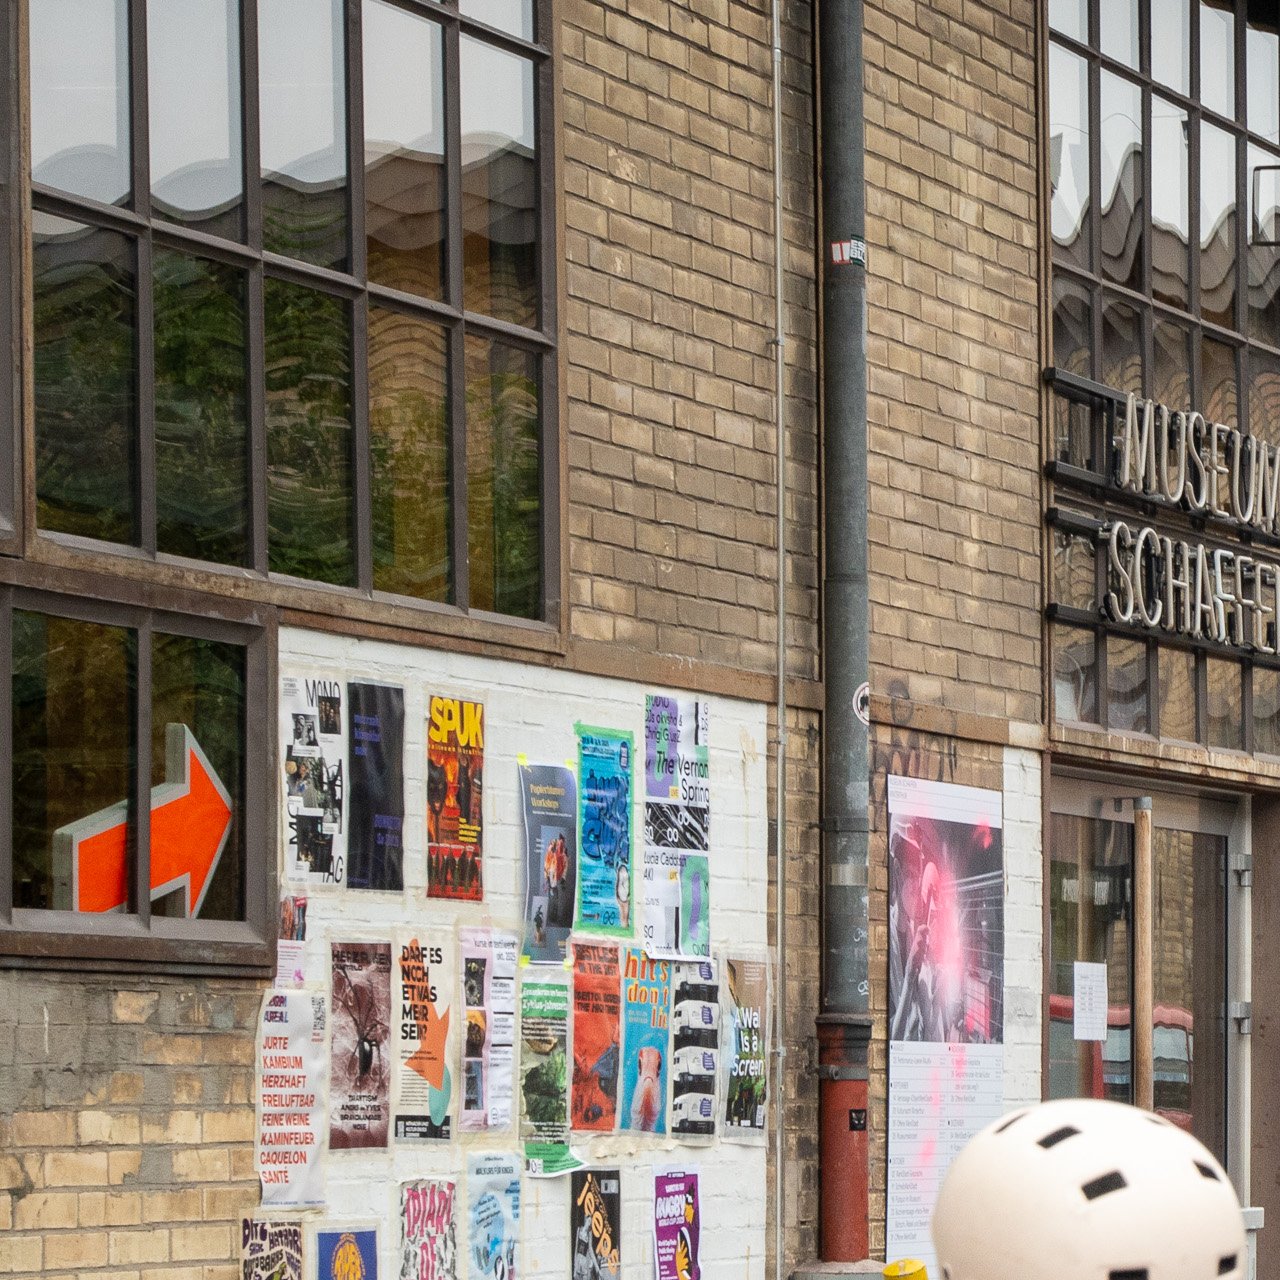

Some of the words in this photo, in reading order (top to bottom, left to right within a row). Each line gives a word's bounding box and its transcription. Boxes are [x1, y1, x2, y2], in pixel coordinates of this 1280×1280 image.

[428, 695, 484, 748] SPUK
[657, 751, 675, 775] The
[677, 753, 709, 778] Vernon
[682, 778, 710, 808] Spring
[402, 945, 427, 963] DARF
[429, 947, 443, 965] ES
[401, 964, 429, 982] NOCH
[624, 949, 669, 983] hits
[401, 984, 438, 1003] ETWAS
[401, 1004, 429, 1021] MEHR
[735, 1007, 744, 1028] A
[262, 1037, 289, 1050] JURTE
[740, 1030, 750, 1052] Is
[752, 1035, 758, 1051] a
[262, 1056, 303, 1069] KAMBIUM
[731, 1054, 764, 1077] Screen
[261, 1075, 307, 1088] HERZHAFT
[262, 1094, 315, 1108] FREILUFTBAR
[261, 1113, 284, 1126] FEINE
[285, 1113, 310, 1126] WEINE
[261, 1132, 315, 1146] KAMINFEUER
[260, 1151, 307, 1165] CAQUELON
[262, 1166, 289, 1184] SANTÉ
[656, 1194, 687, 1220] RUGBY
